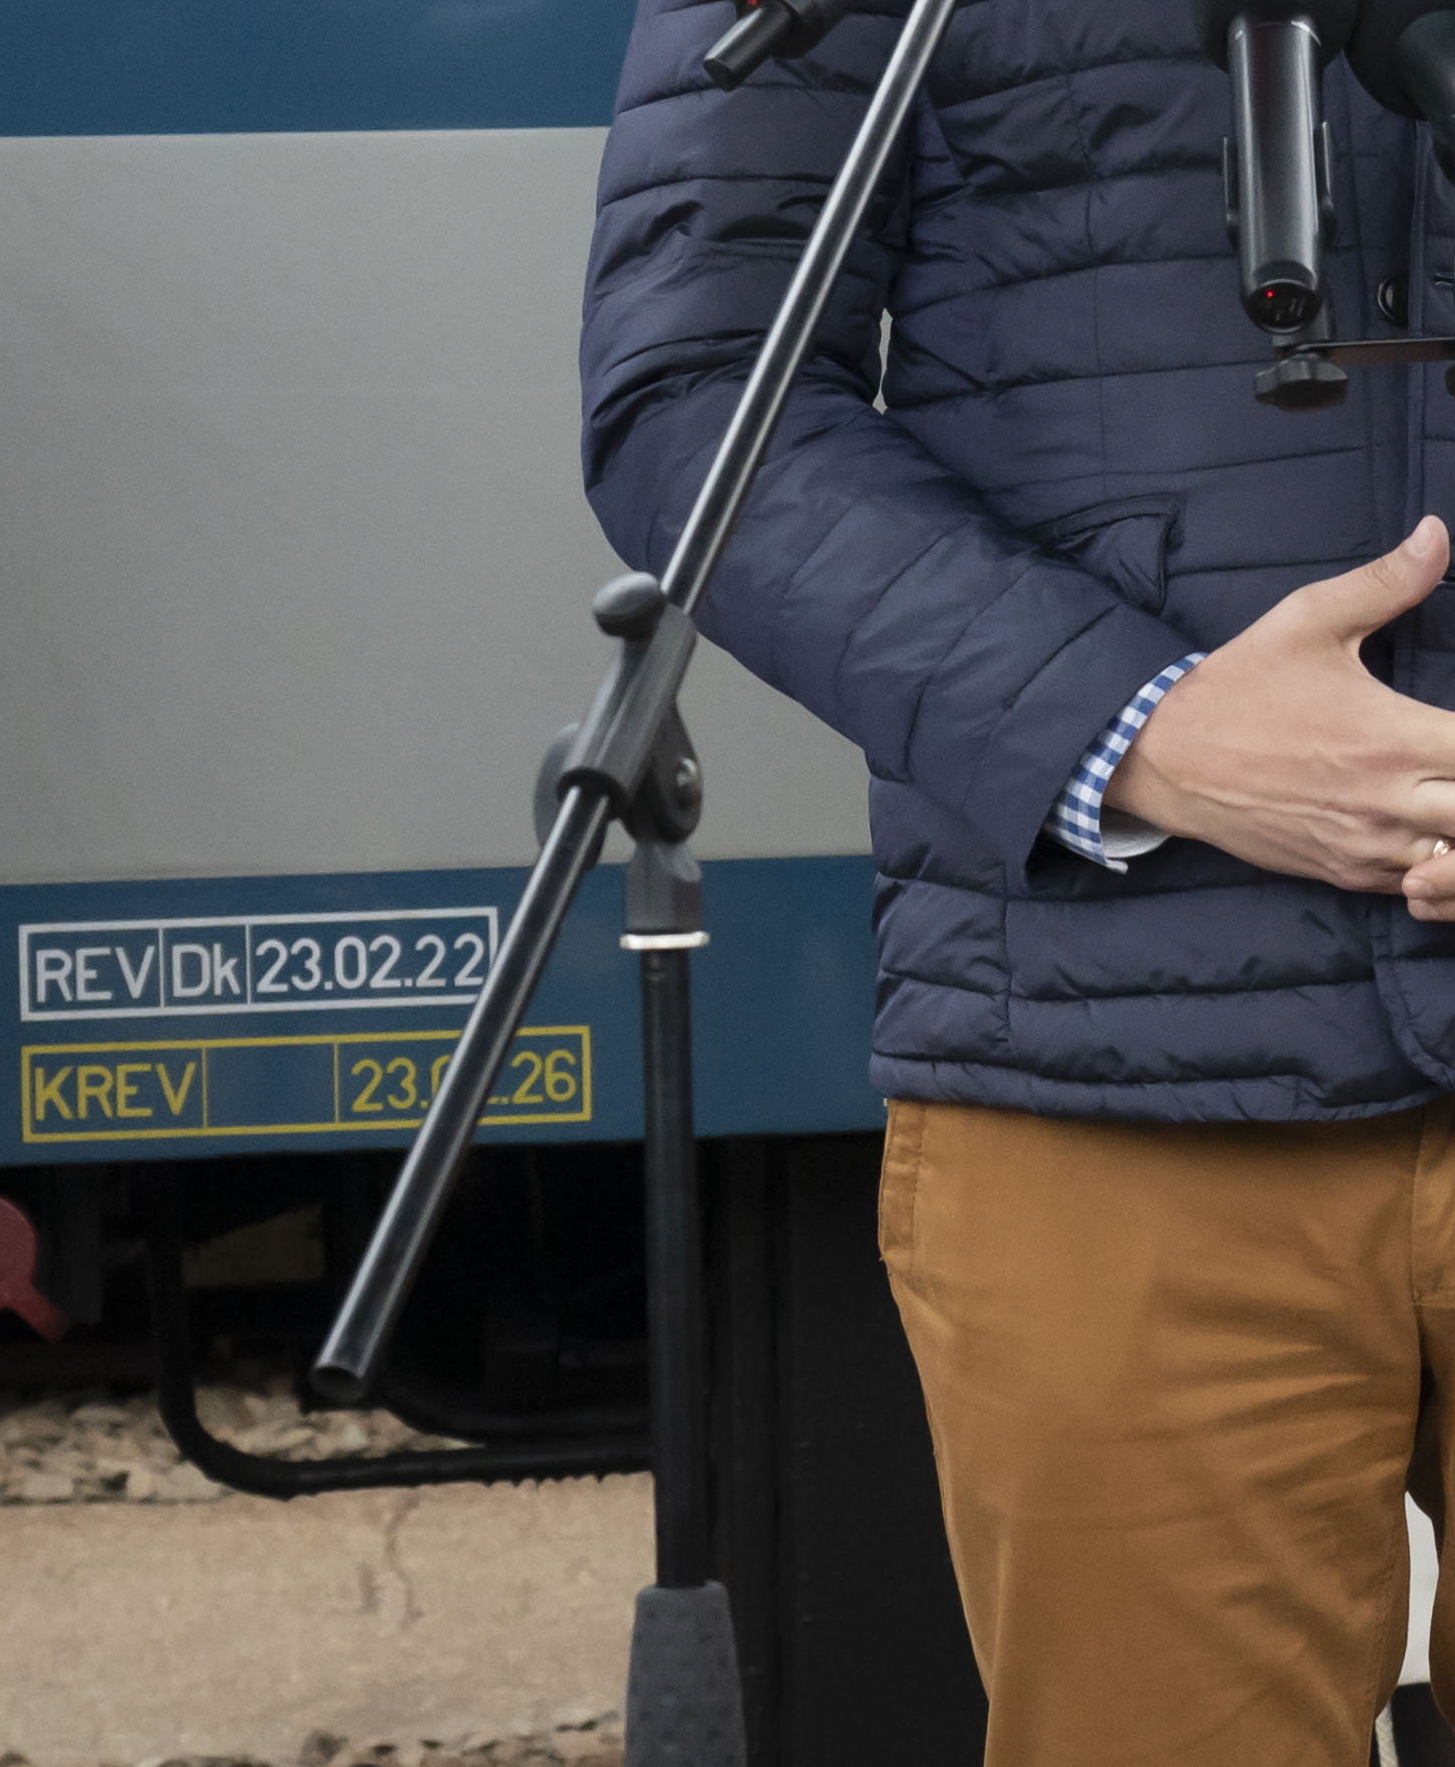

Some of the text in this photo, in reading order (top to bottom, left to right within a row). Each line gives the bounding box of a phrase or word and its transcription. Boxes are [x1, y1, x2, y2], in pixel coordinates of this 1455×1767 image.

[34, 930, 485, 1003] REV Dk 23.02.22
[34, 1049, 577, 1121] KREV 23..26
